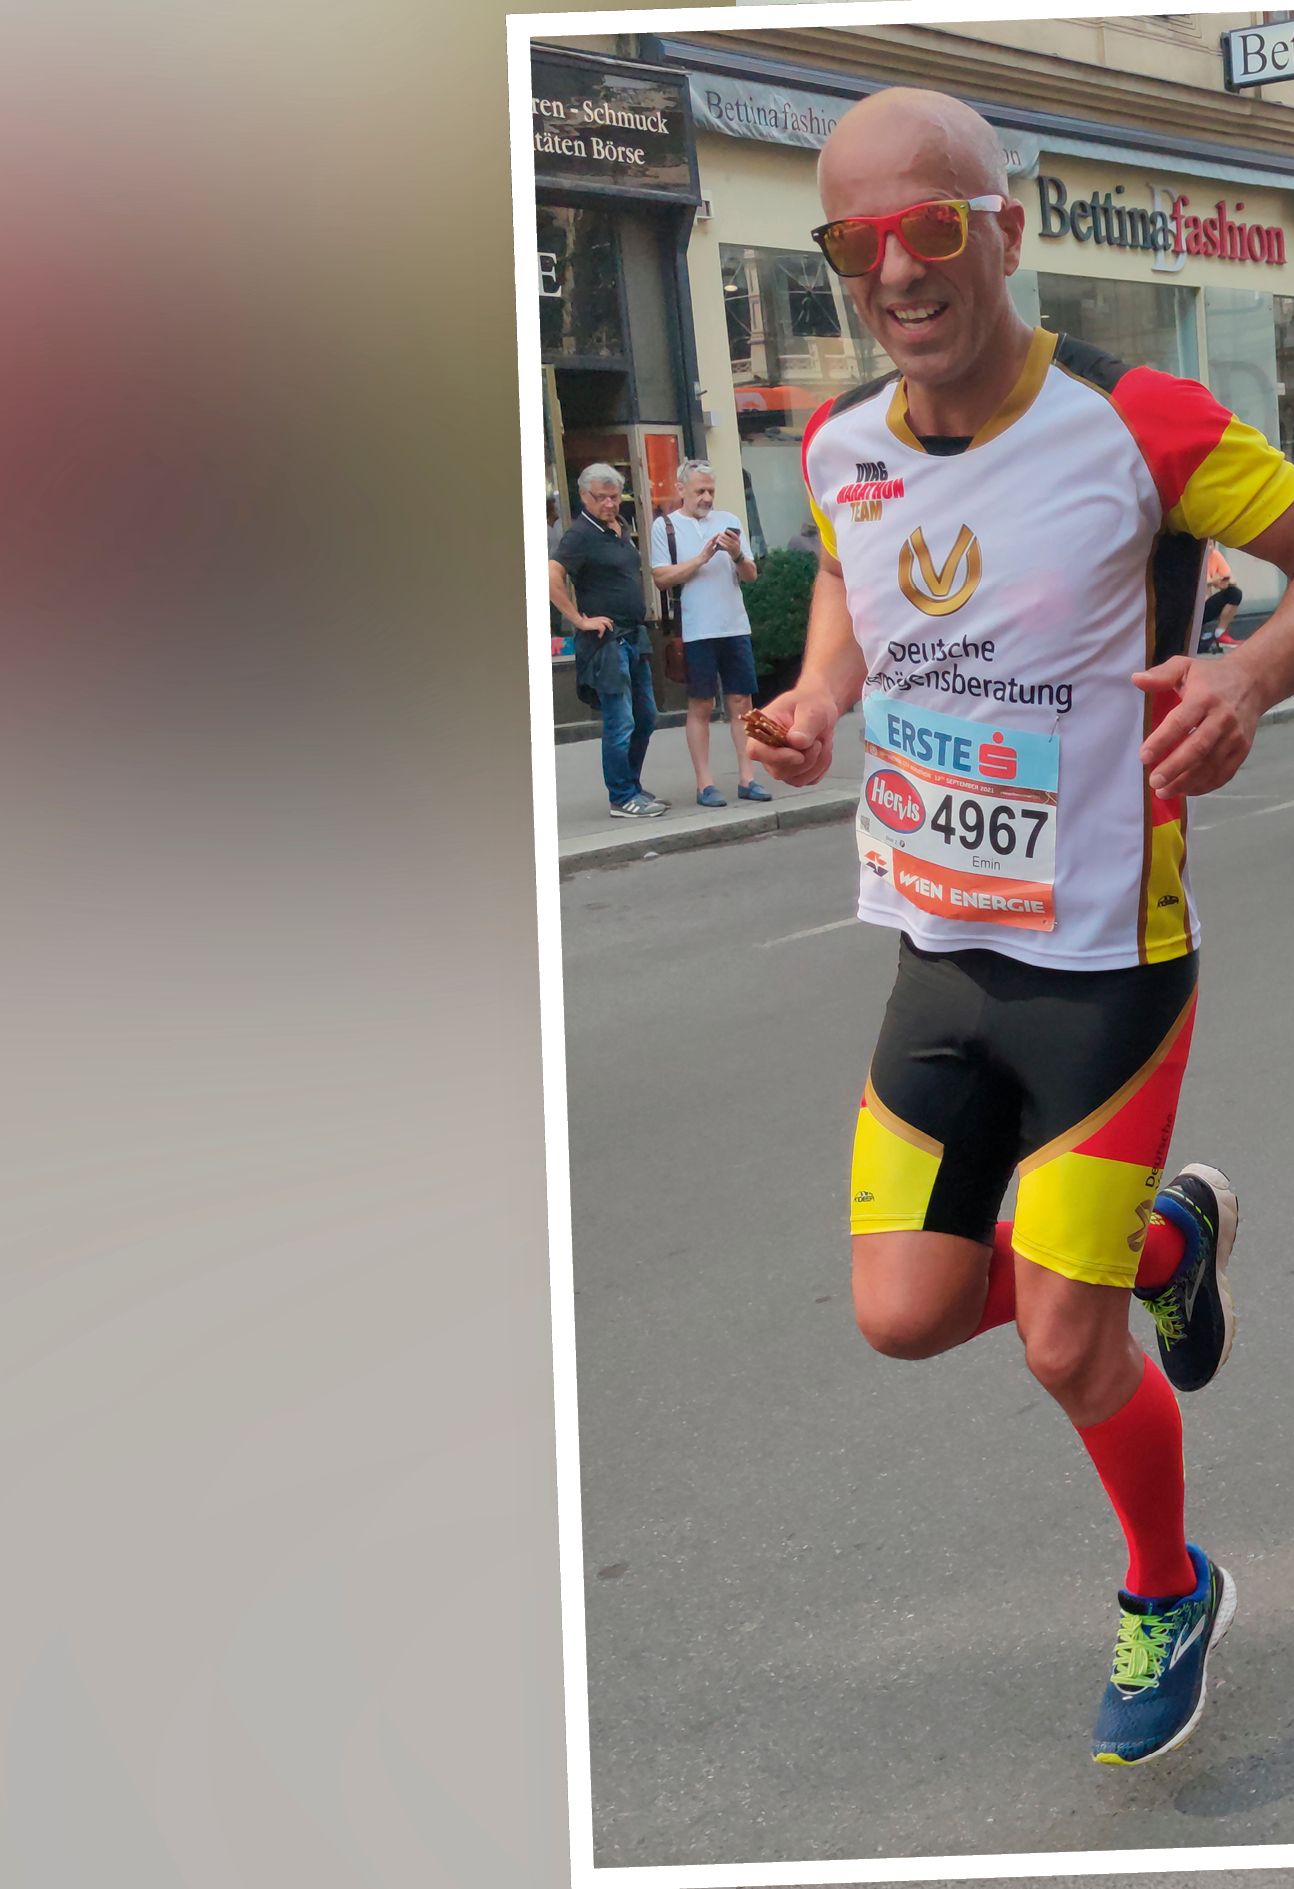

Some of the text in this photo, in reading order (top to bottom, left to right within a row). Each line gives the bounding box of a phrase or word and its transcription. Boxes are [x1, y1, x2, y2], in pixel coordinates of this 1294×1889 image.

[582, 100, 670, 134] Schmuck
[705, 90, 837, 136] Bettina fashio
[533, 133, 646, 165] täten Börse
[1037, 175, 1288, 265] Bettina fashion
[855, 461, 889, 483] DVAG
[836, 478, 904, 504] MARATHON
[850, 500, 883, 522] TEAM
[887, 634, 995, 664] Deutsche
[887, 713, 972, 772] ERSTE
[946, 778, 979, 791] SEPTEMBER
[871, 777, 1049, 859] Hervis 4967
[972, 855, 1001, 871] Emin
[899, 870, 1046, 914] WIEN ENERGIE
